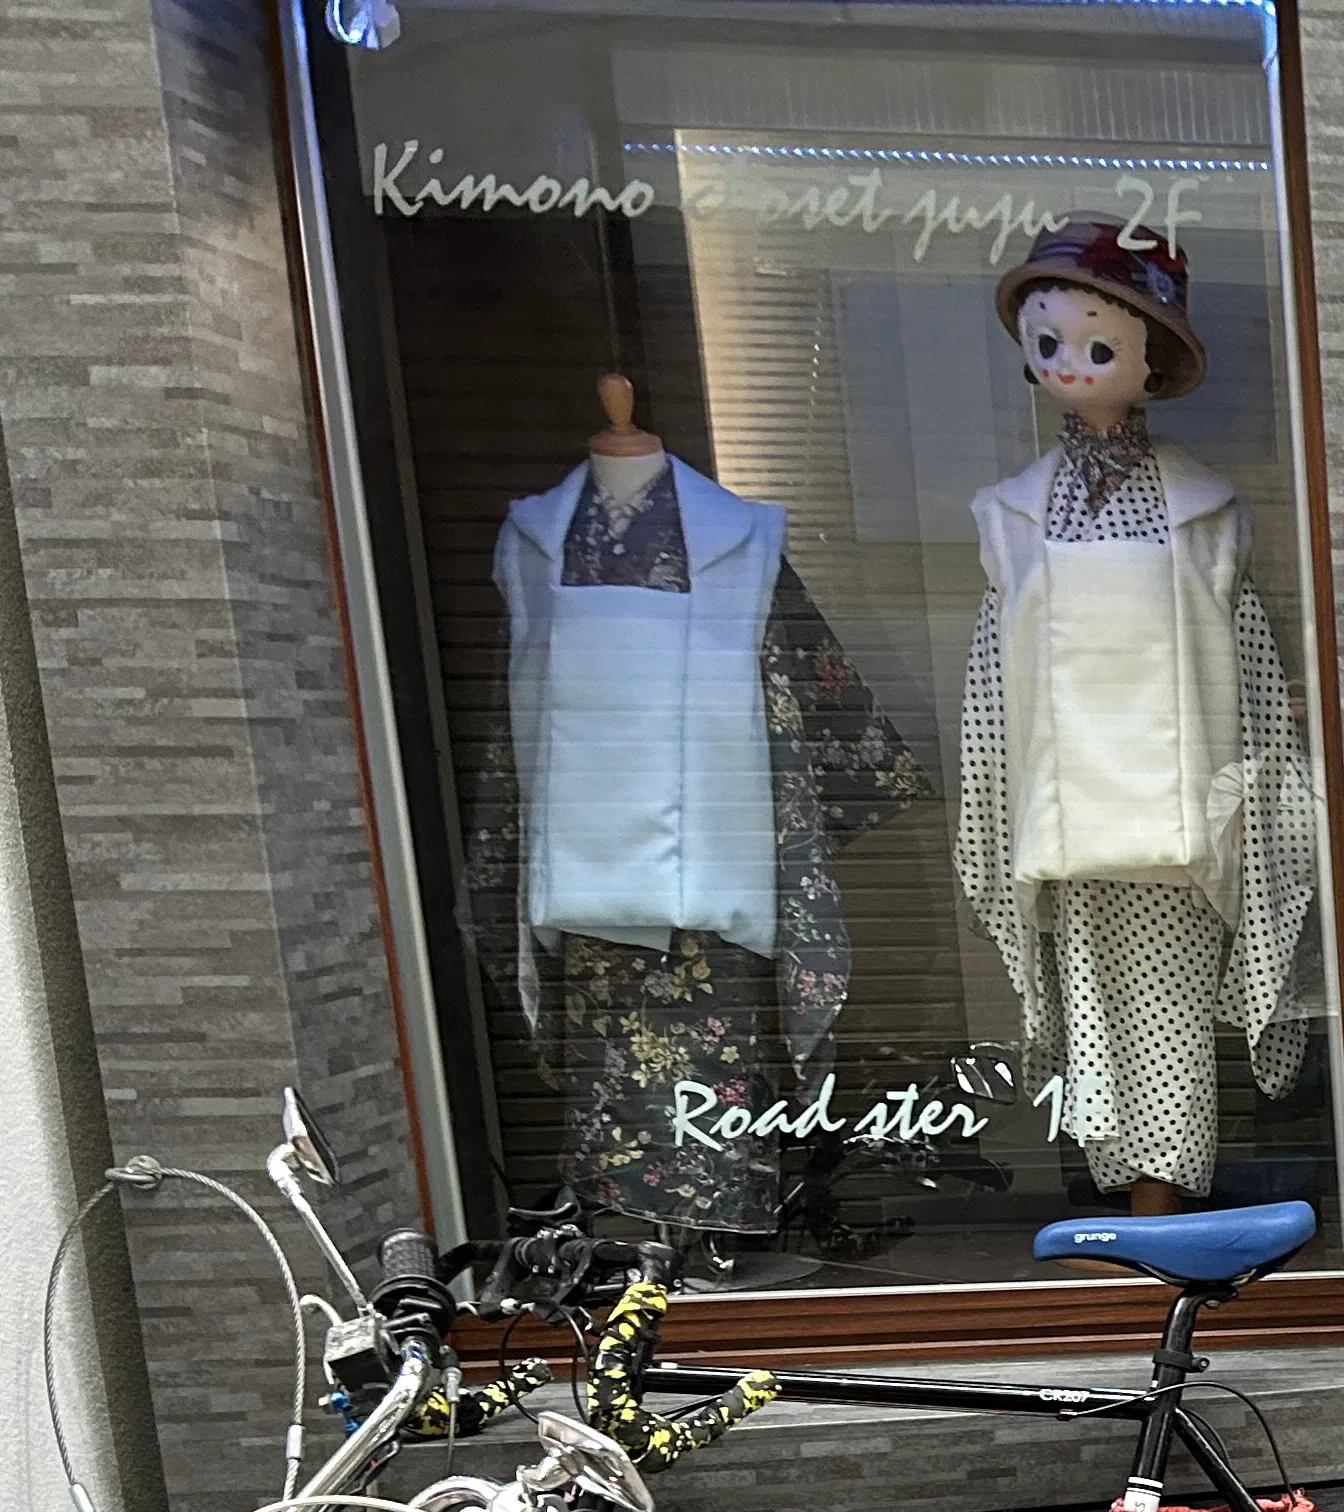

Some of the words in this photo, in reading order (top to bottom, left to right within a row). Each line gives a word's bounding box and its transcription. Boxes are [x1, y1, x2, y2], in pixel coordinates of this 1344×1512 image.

[374, 140, 655, 218] Kimono
[685, 166, 896, 233] coset
[901, 188, 1070, 264] juju
[1116, 176, 1202, 261] 2F
[1073, 1232, 1117, 1244] grunge
